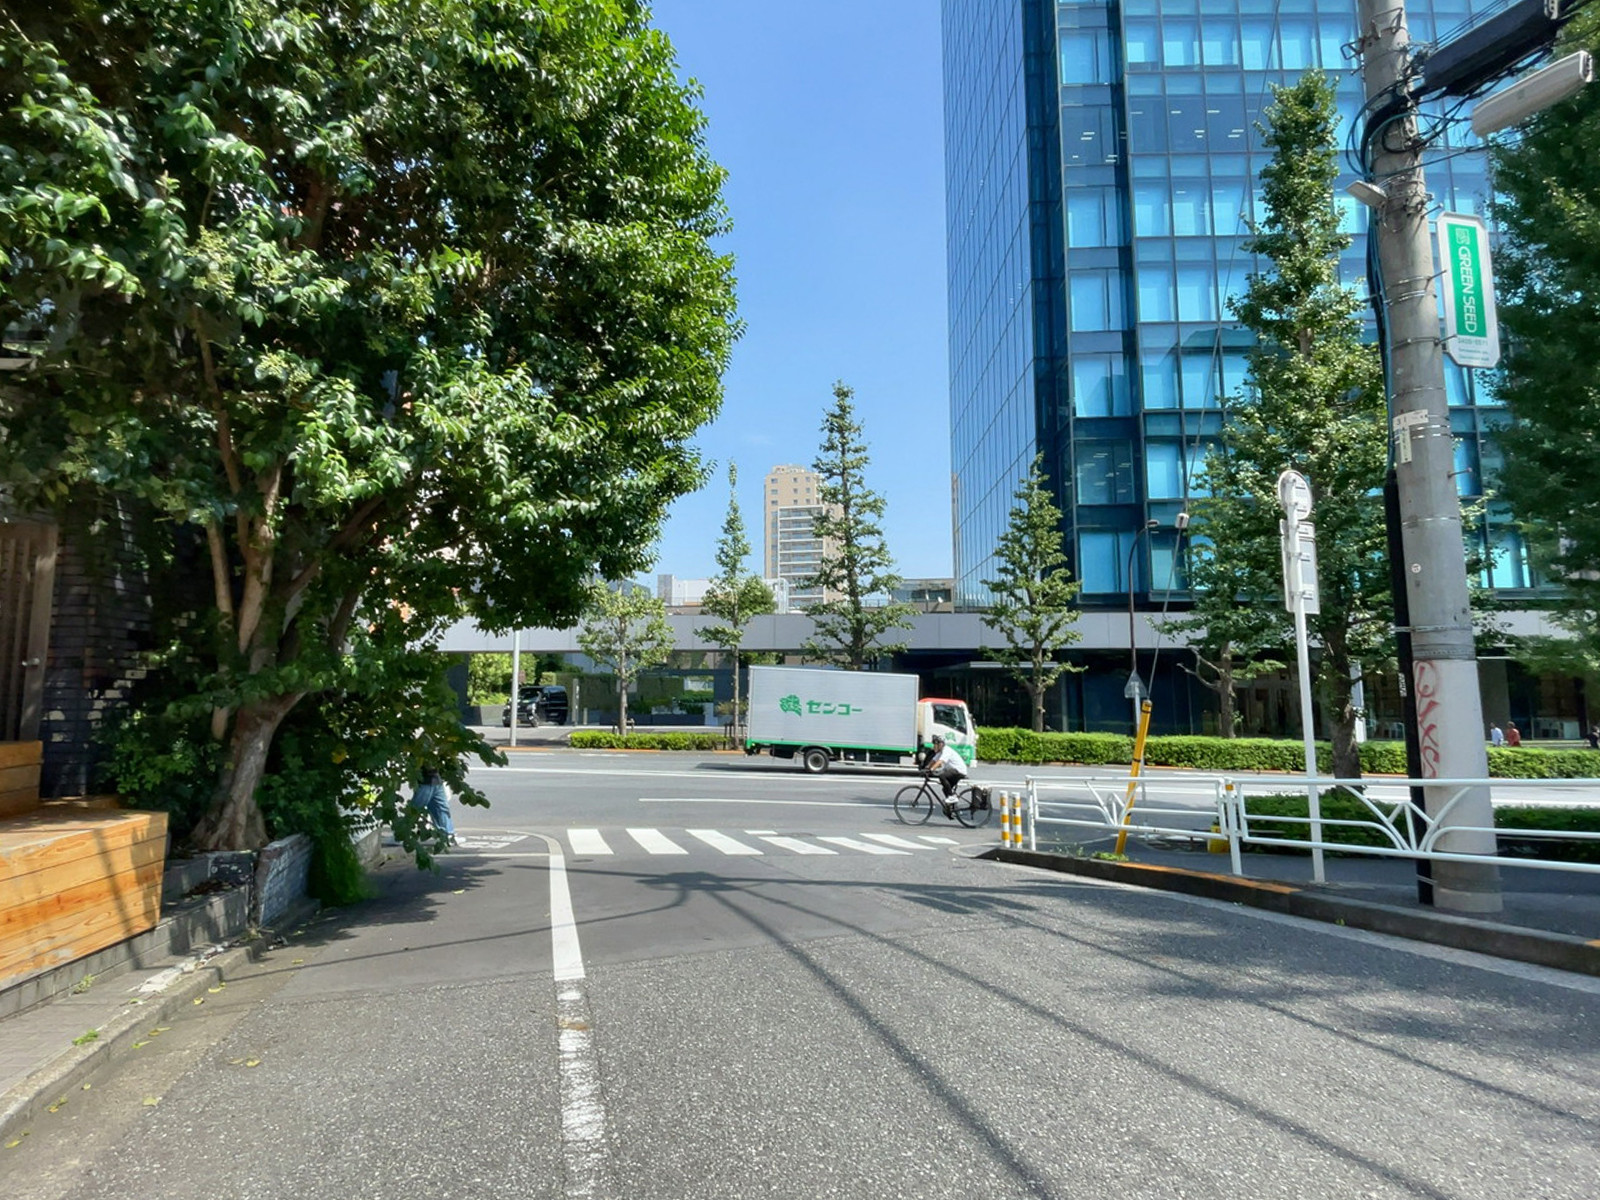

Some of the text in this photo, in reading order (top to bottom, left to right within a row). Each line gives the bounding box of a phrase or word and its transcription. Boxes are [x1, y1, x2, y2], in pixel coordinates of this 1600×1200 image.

[1459, 246, 1474, 294] GREEN
[1463, 295, 1477, 333] SEED
[806, 700, 862, 716] センコー
